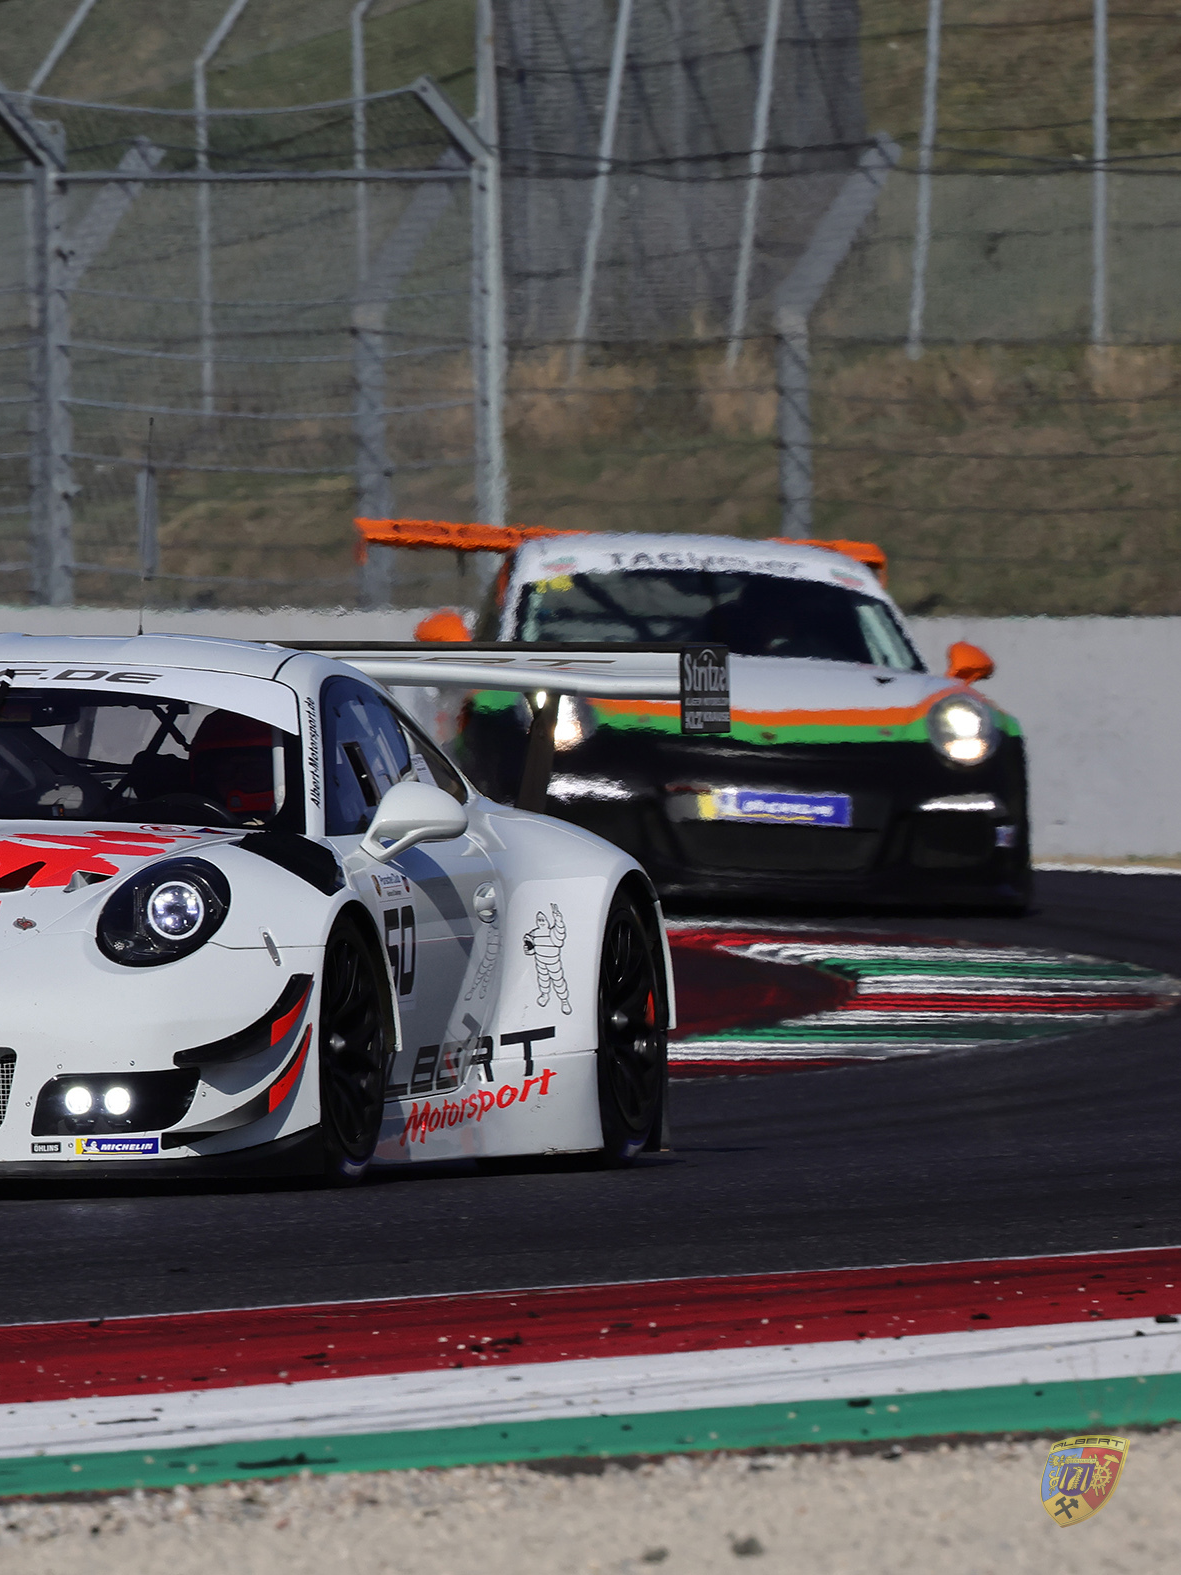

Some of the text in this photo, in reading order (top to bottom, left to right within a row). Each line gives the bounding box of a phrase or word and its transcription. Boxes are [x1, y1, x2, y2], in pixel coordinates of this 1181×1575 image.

[385, 1026, 556, 1099] LBERT
[399, 1068, 558, 1147] Motorsport
[33, 1143, 60, 1152] ÖHLINS
[100, 1143, 154, 1151] MICHELIN
